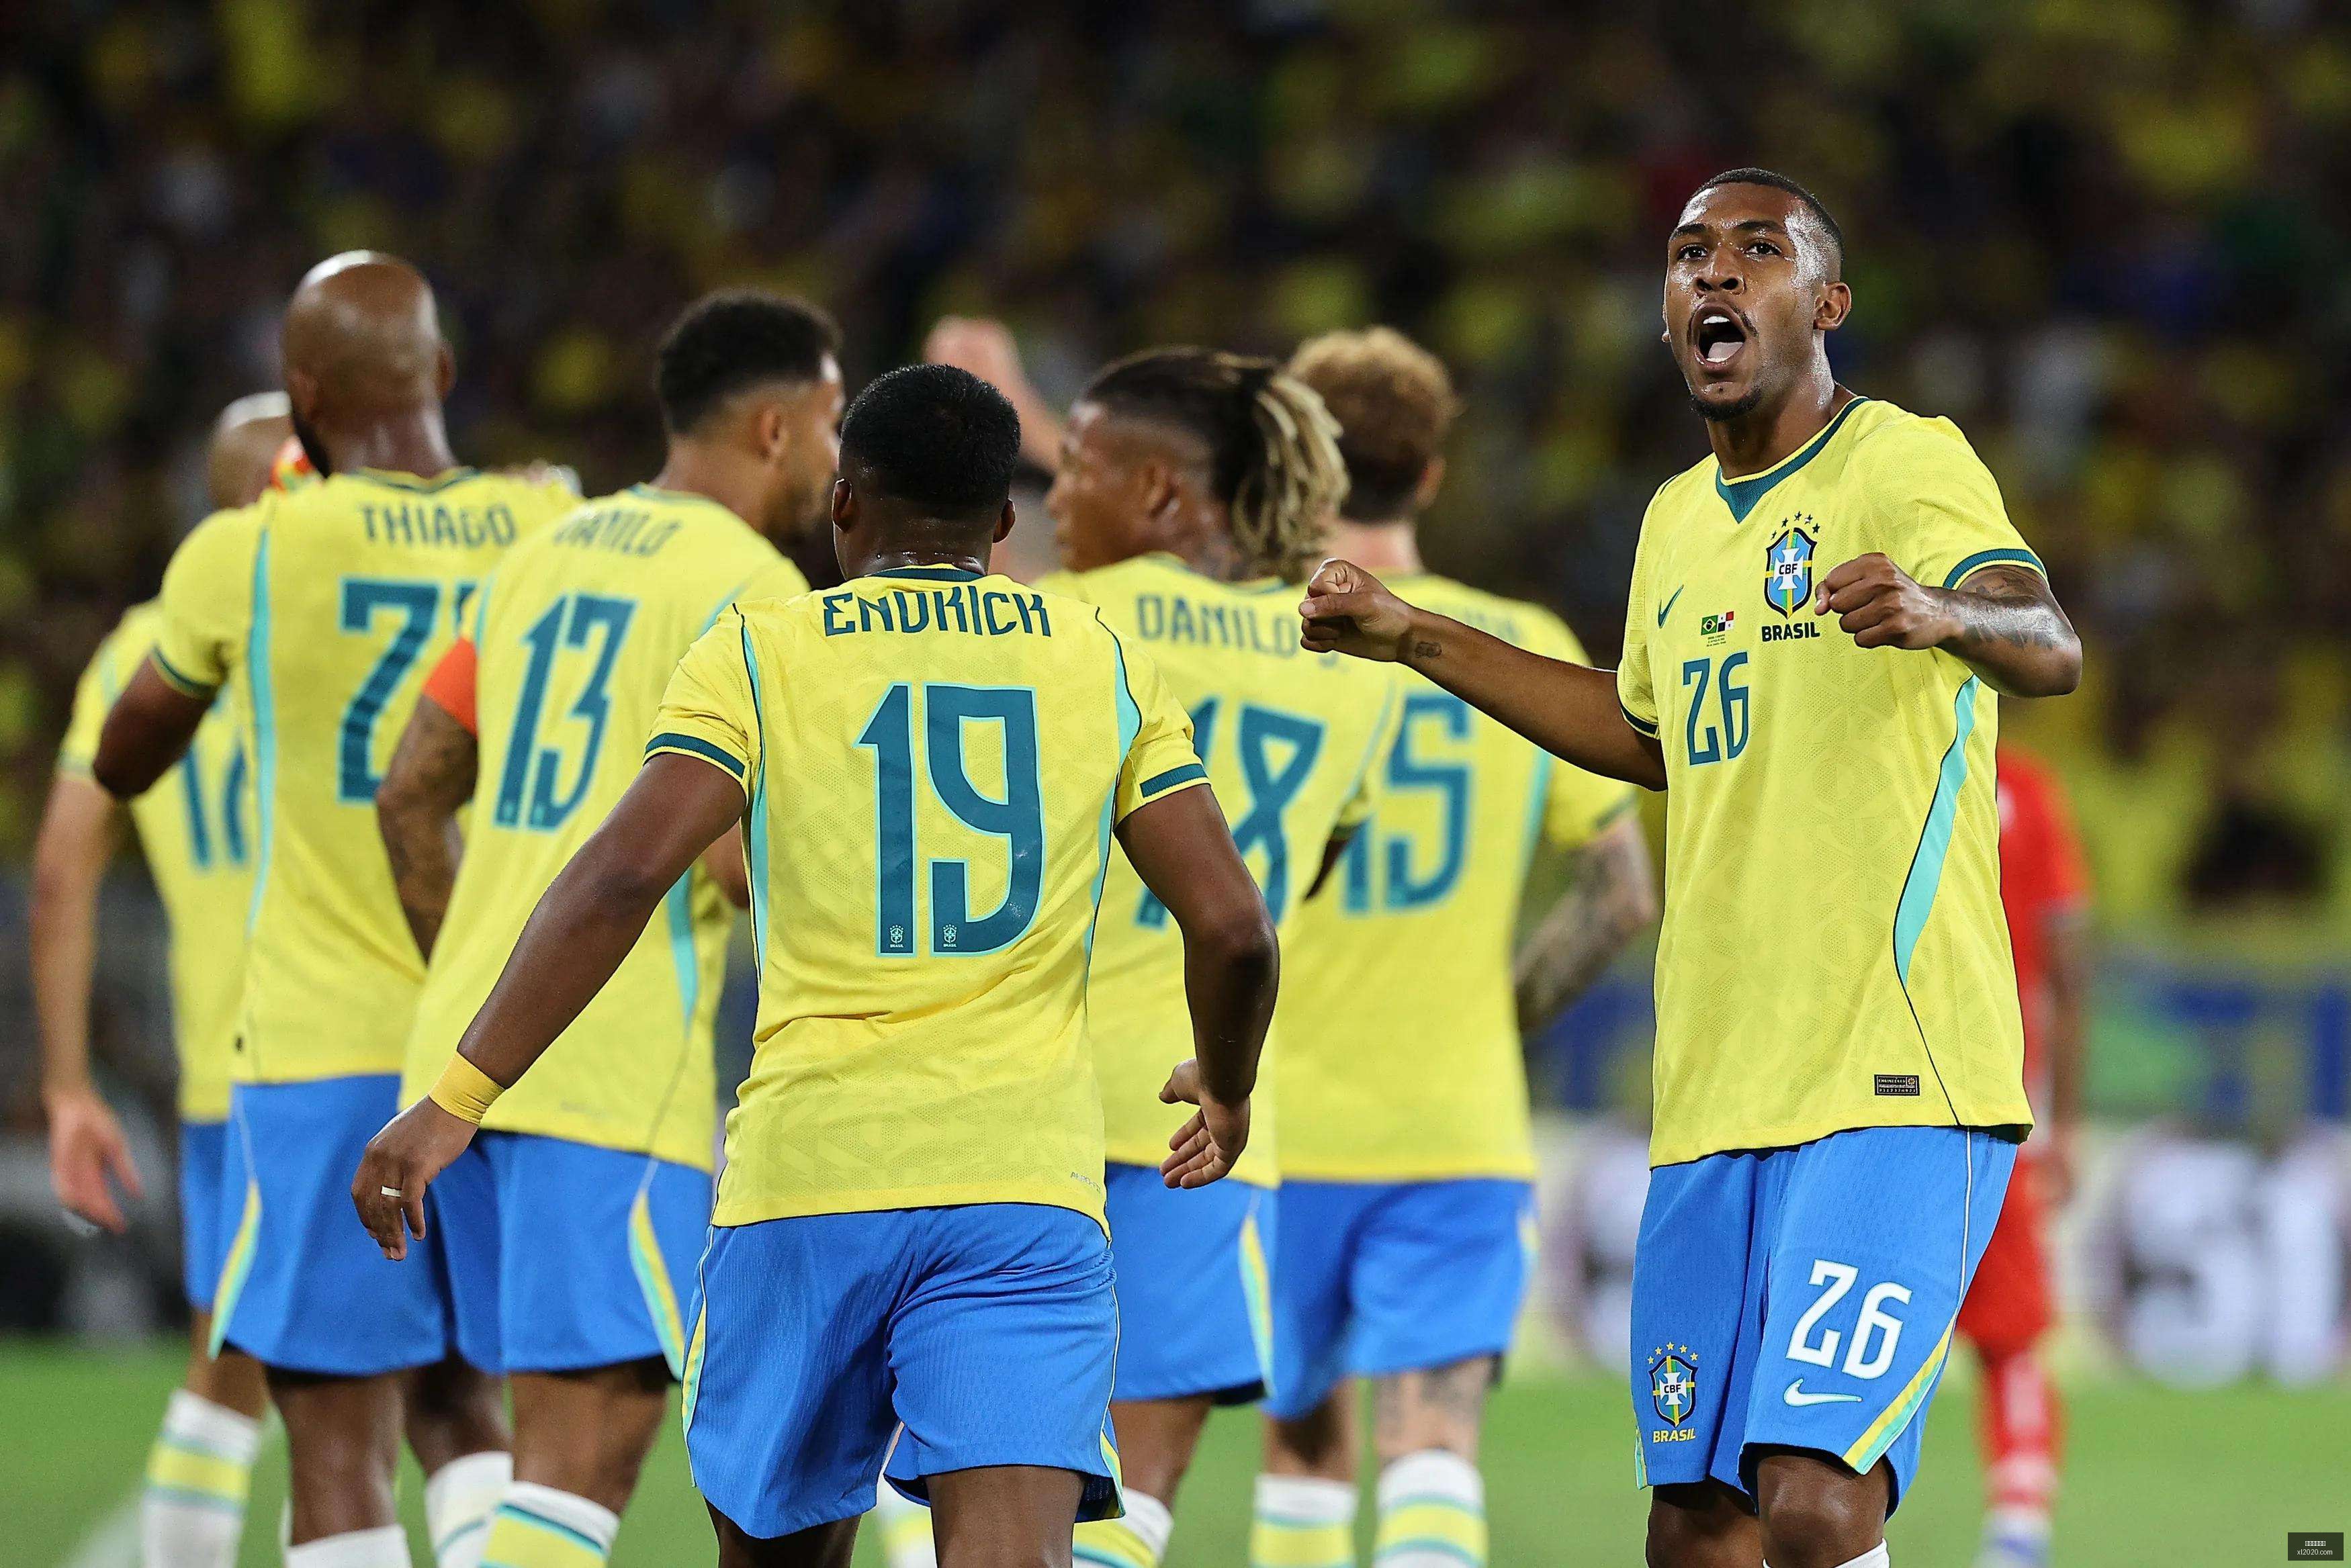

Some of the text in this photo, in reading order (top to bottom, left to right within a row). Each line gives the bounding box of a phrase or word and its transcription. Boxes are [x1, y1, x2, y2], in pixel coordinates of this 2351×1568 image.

[363, 504, 515, 547] THIAGO
[1779, 563, 1798, 575] CBF
[823, 585, 1052, 637] ENDRICK
[1137, 594, 1300, 658] DANILO
[1761, 621, 1820, 642] BRASIL
[493, 590, 639, 833] 13
[1681, 650, 1749, 766] 26
[852, 681, 1047, 958] 19
[1785, 1258, 1913, 1379] 26
[1664, 1384, 1681, 1393] CBF
[1653, 1428, 1697, 1444] BRASIL
